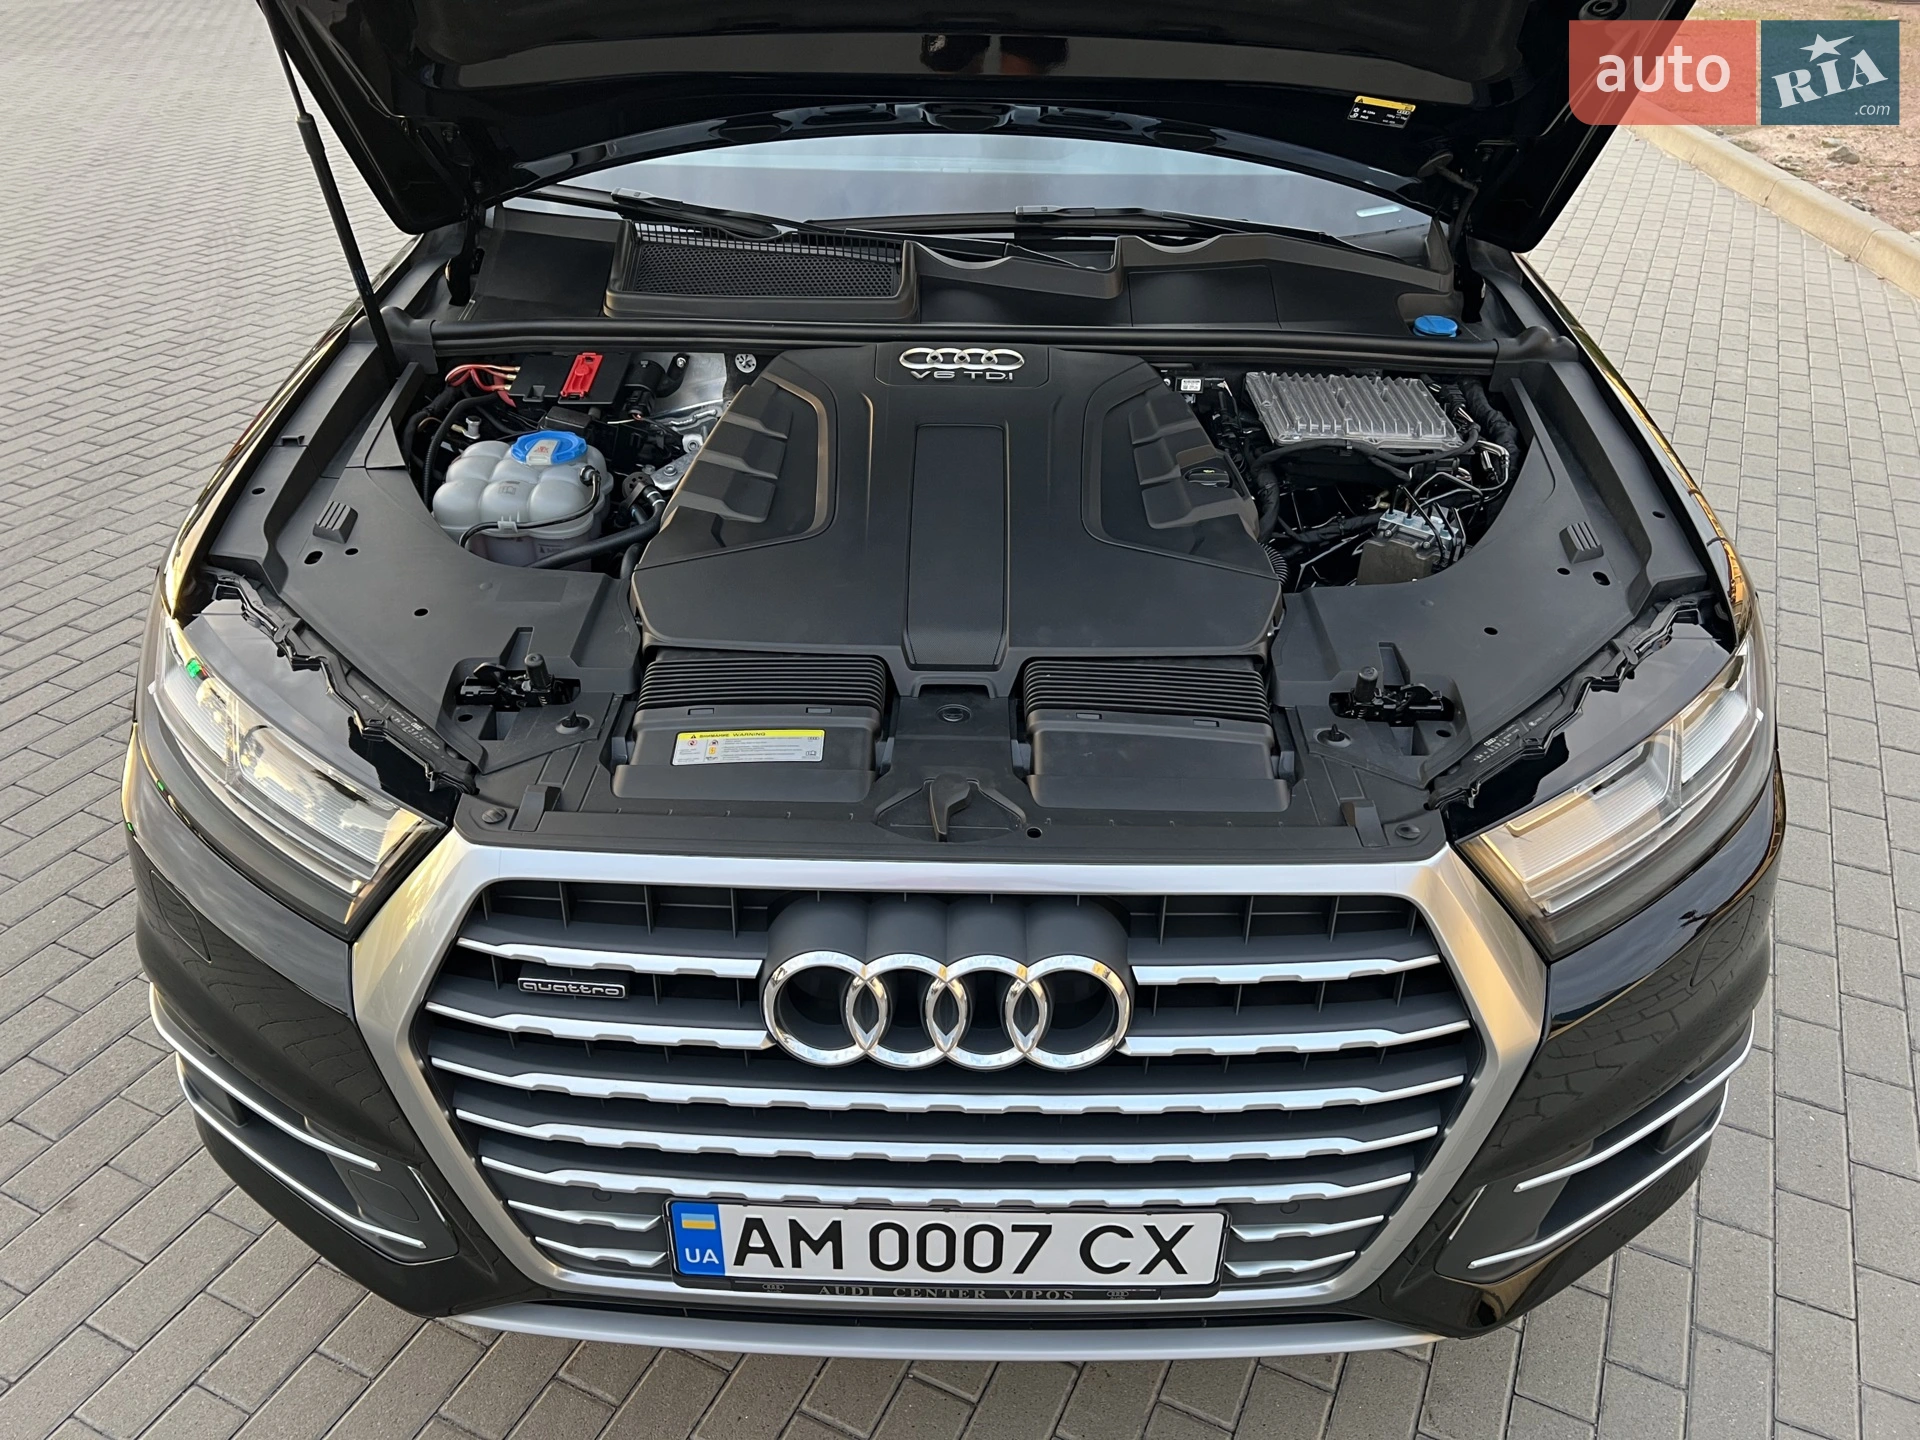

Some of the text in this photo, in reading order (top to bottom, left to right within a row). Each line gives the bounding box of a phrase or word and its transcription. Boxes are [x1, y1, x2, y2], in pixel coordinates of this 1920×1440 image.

[910, 370, 1013, 381] V6 TDI
[522, 982, 620, 995] quattro
[733, 1217, 1195, 1275] AM 0007 CX
[684, 1247, 720, 1265] UA
[819, 1285, 1074, 1300] AUDI CENTER VIPOS
